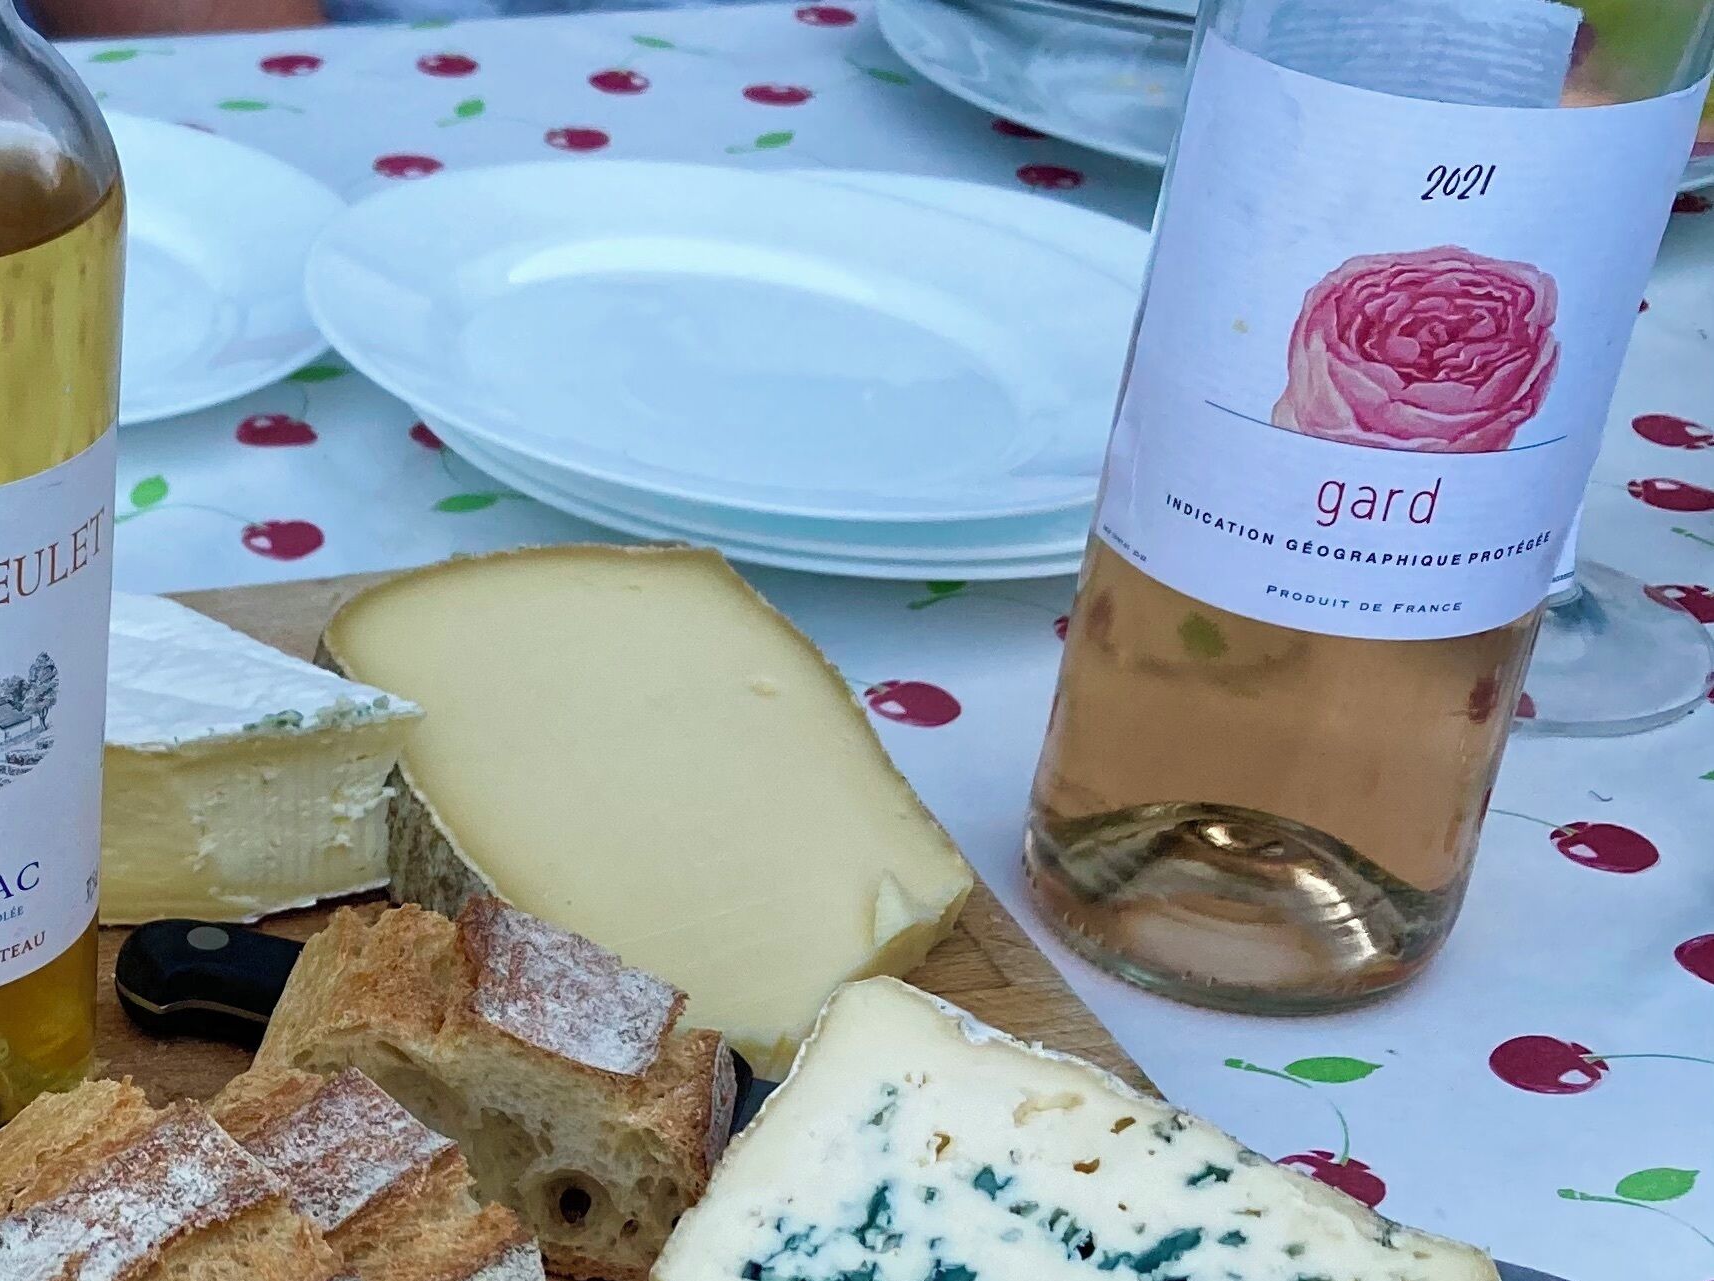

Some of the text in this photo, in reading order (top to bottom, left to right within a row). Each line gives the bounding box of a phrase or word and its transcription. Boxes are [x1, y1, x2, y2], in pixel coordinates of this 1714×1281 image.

[1421, 164, 1496, 200] 2021
[1316, 477, 1442, 527] gard
[1166, 493, 1275, 546] INDICATION
[1286, 538, 1461, 566] GÉOGRAPHIQUE
[1468, 530, 1551, 564] PROTÉGÉE
[1266, 584, 1463, 613] PRODUIT DE FRANCE
